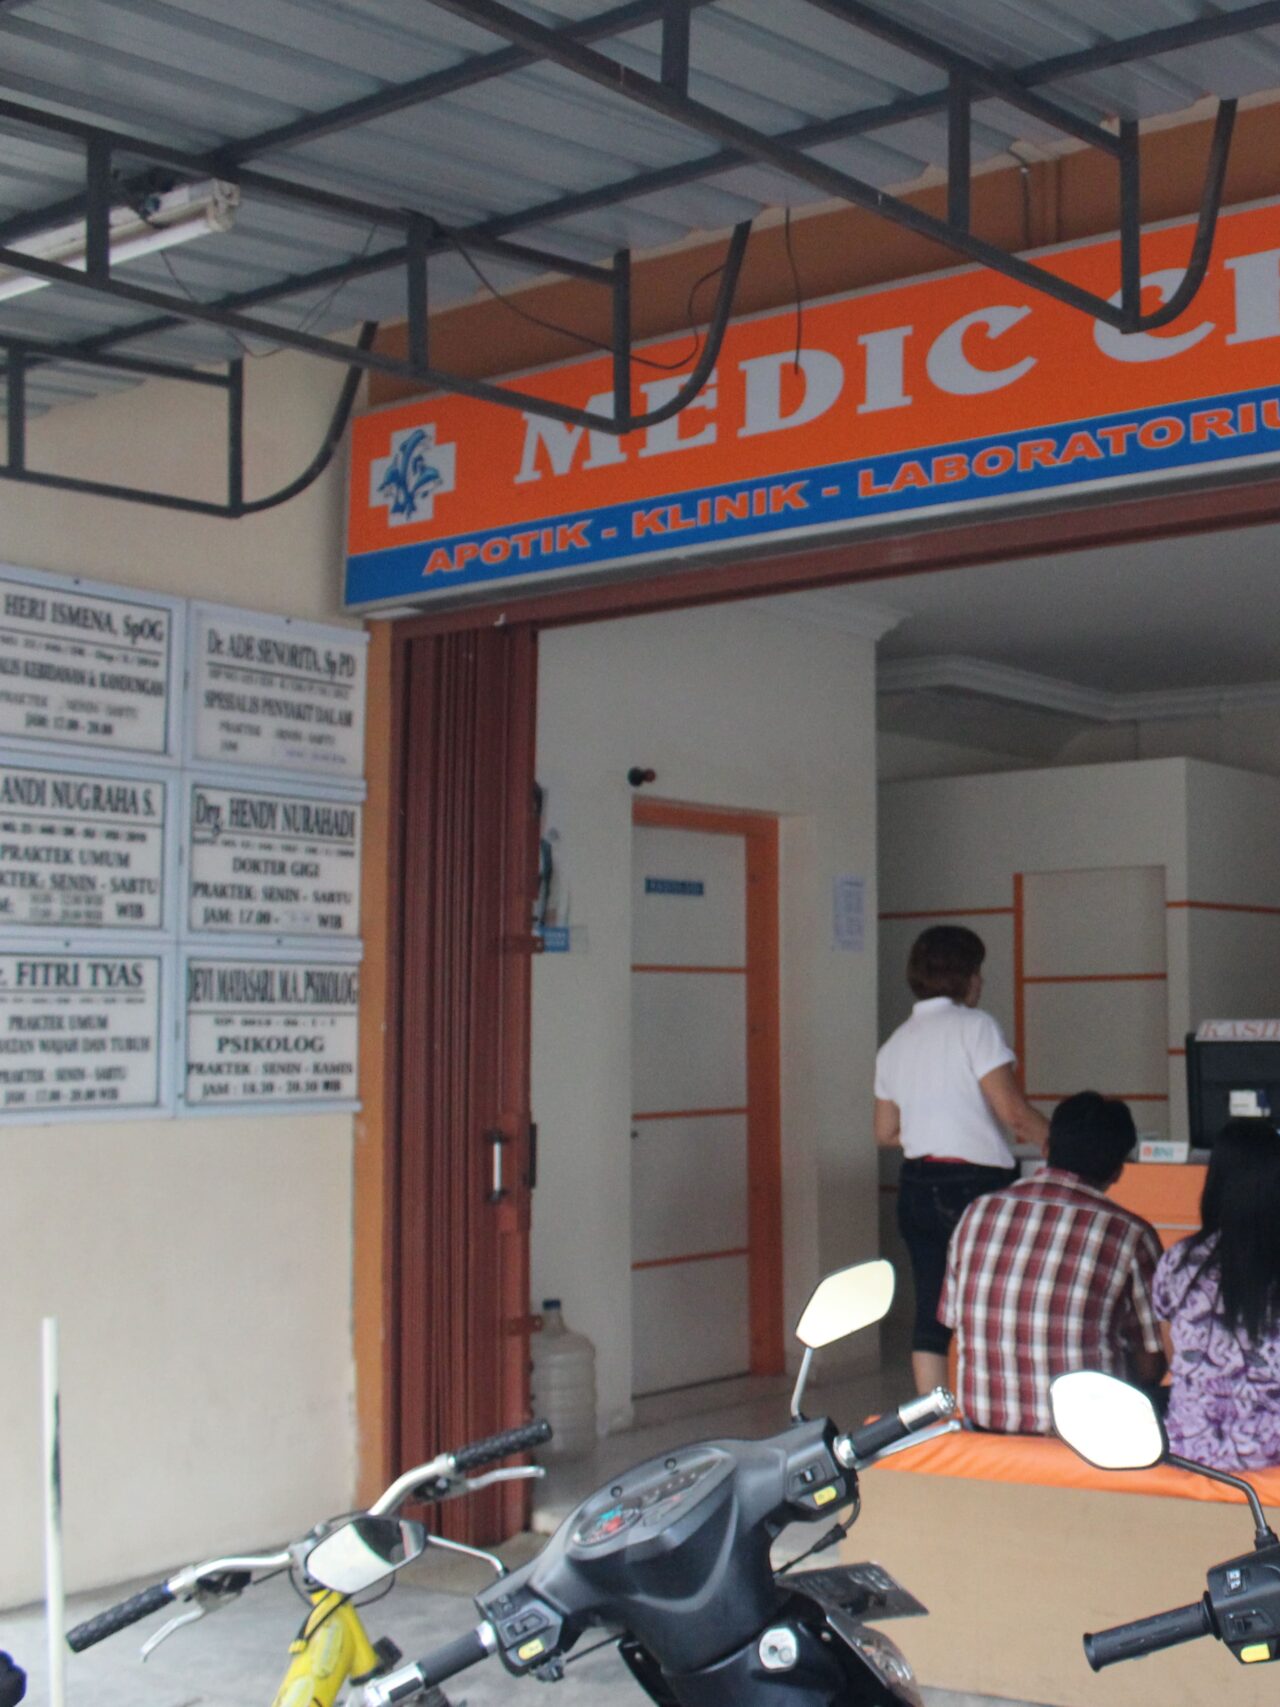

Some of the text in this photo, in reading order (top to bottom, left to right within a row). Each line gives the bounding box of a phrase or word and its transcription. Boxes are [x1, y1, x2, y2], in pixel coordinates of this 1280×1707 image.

[512, 305, 1037, 484] MEDIC
[422, 519, 593, 575] APOTIK
[631, 481, 809, 541] KLINIK
[4, 592, 47, 622] HERI
[1, 777, 47, 807] ANDI
[52, 780, 140, 816] NUGRAHA
[228, 797, 278, 831] HENDY
[281, 803, 355, 838] NURAHADI
[79, 850, 132, 869] UMUM
[232, 856, 321, 879] DOKTER GIGI
[51, 873, 97, 891] SENIN
[110, 876, 158, 895] SABTU
[317, 913, 343, 930] WIB
[16, 961, 80, 987] FITRI
[87, 961, 145, 988] TYAS
[216, 1035, 325, 1054] PSIKOLOG
[262, 1061, 302, 1076] SENIN
[312, 1061, 353, 1076] KAMIS
